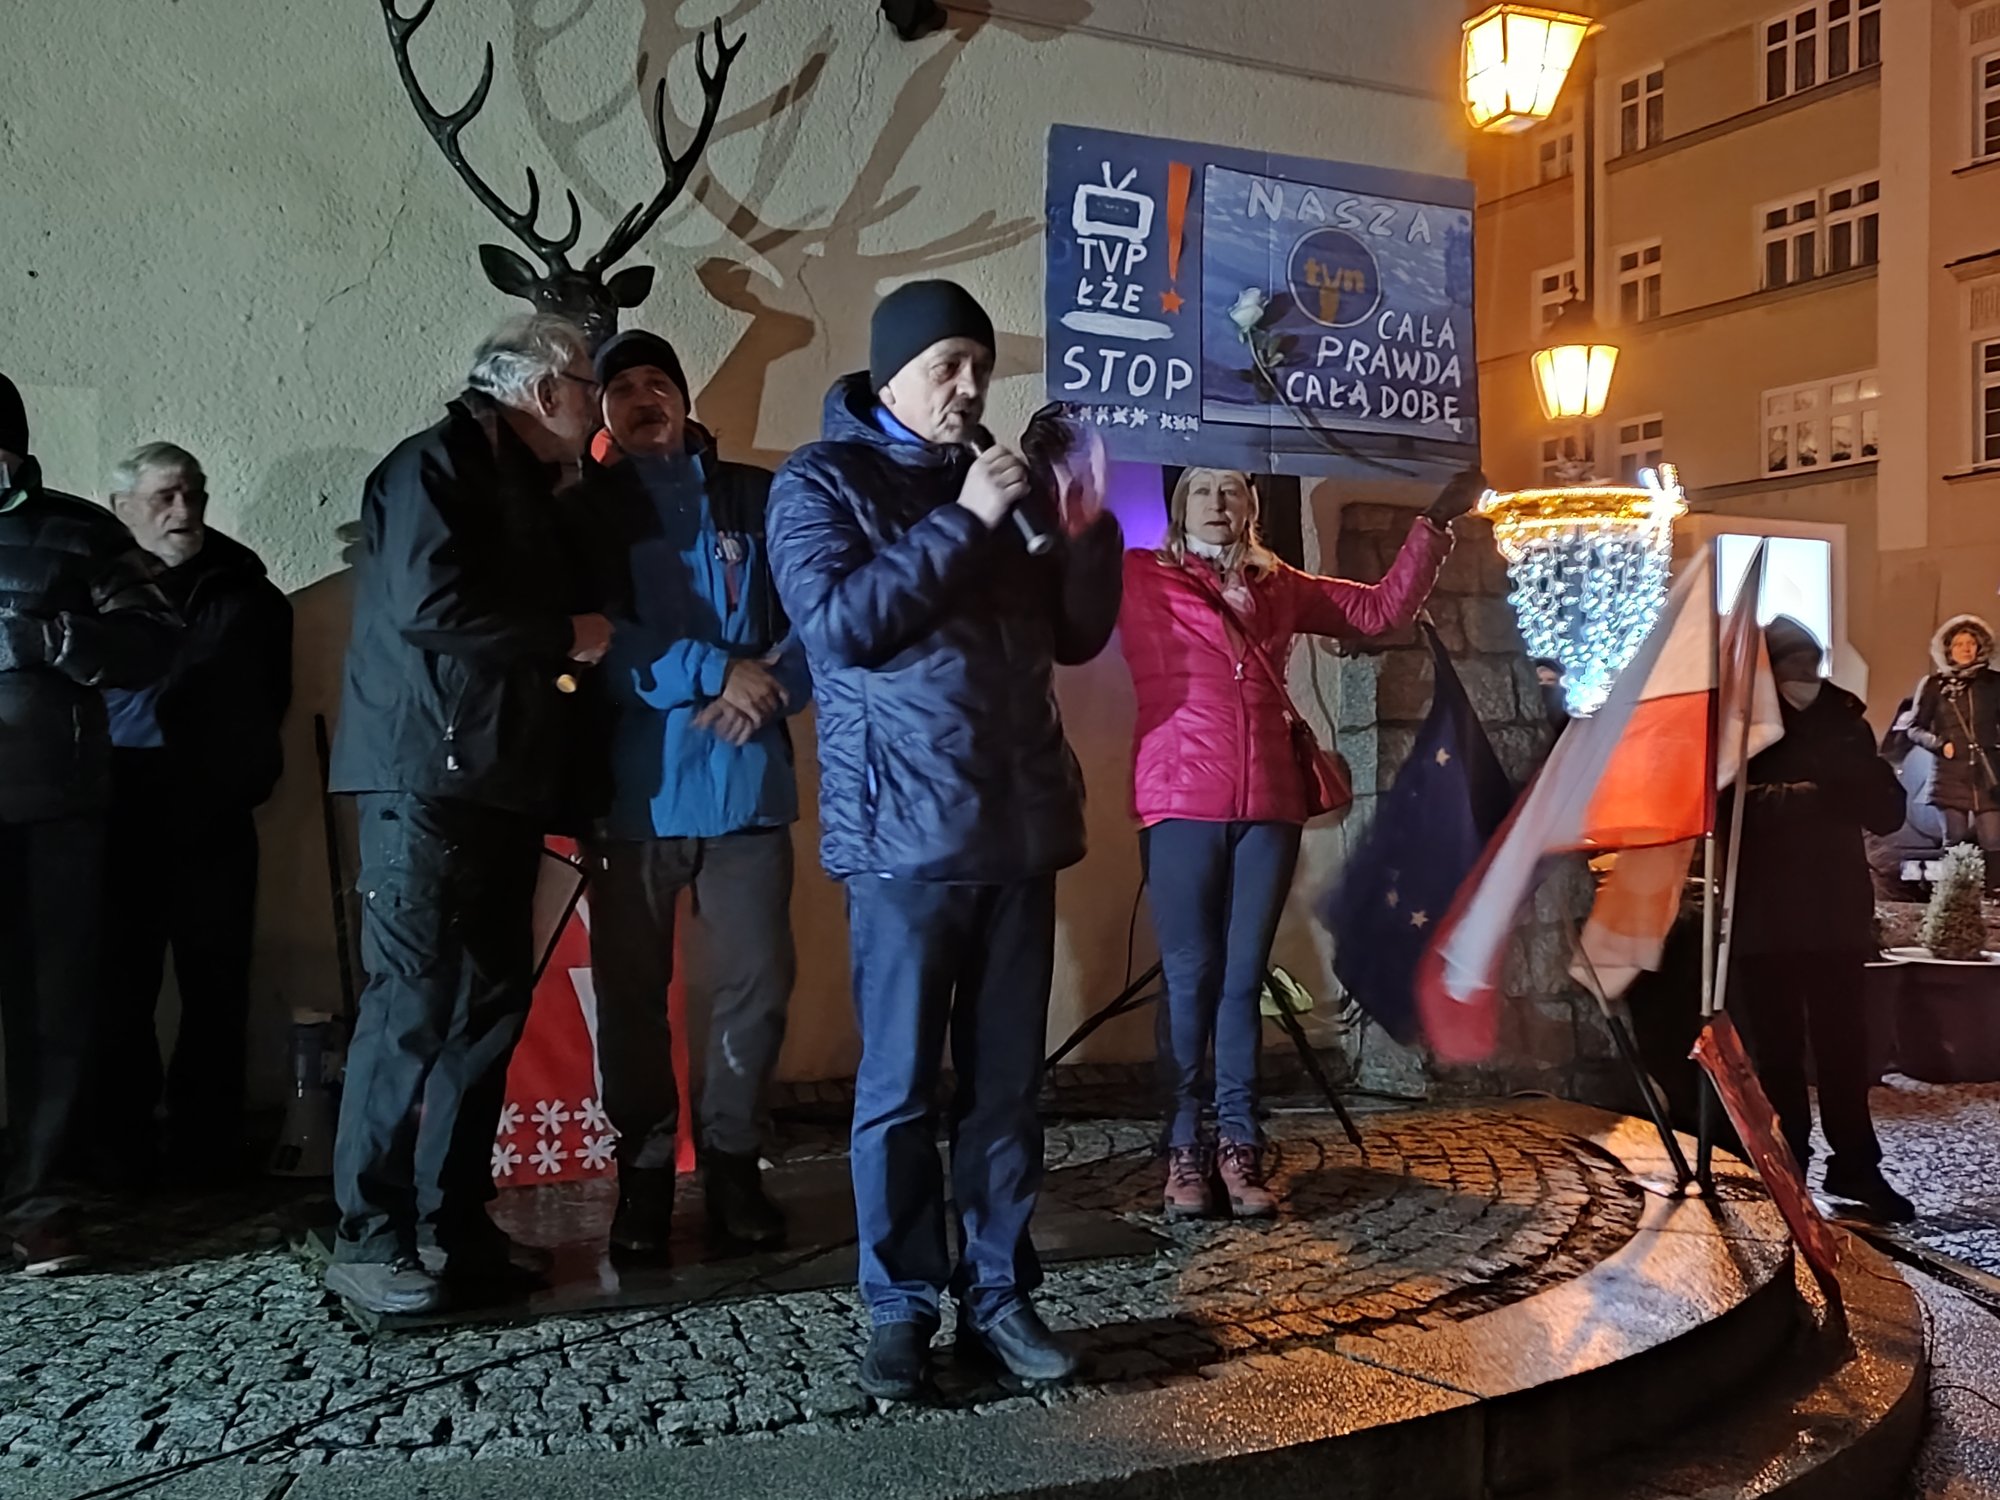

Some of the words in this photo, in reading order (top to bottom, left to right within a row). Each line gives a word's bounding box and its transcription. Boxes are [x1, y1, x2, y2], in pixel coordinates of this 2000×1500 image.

[1247, 180, 1431, 244] NASZA
[1076, 237, 1148, 275] TVP
[1304, 257, 1365, 294] tvn
[1077, 275, 1144, 313] ŁŻE
[1377, 310, 1455, 350] CAŁA
[1063, 346, 1193, 400] STOP
[1316, 336, 1461, 388] PRAWDA
[1286, 371, 1371, 418] CAŁĄ
[1379, 385, 1463, 433] DOBĘ
